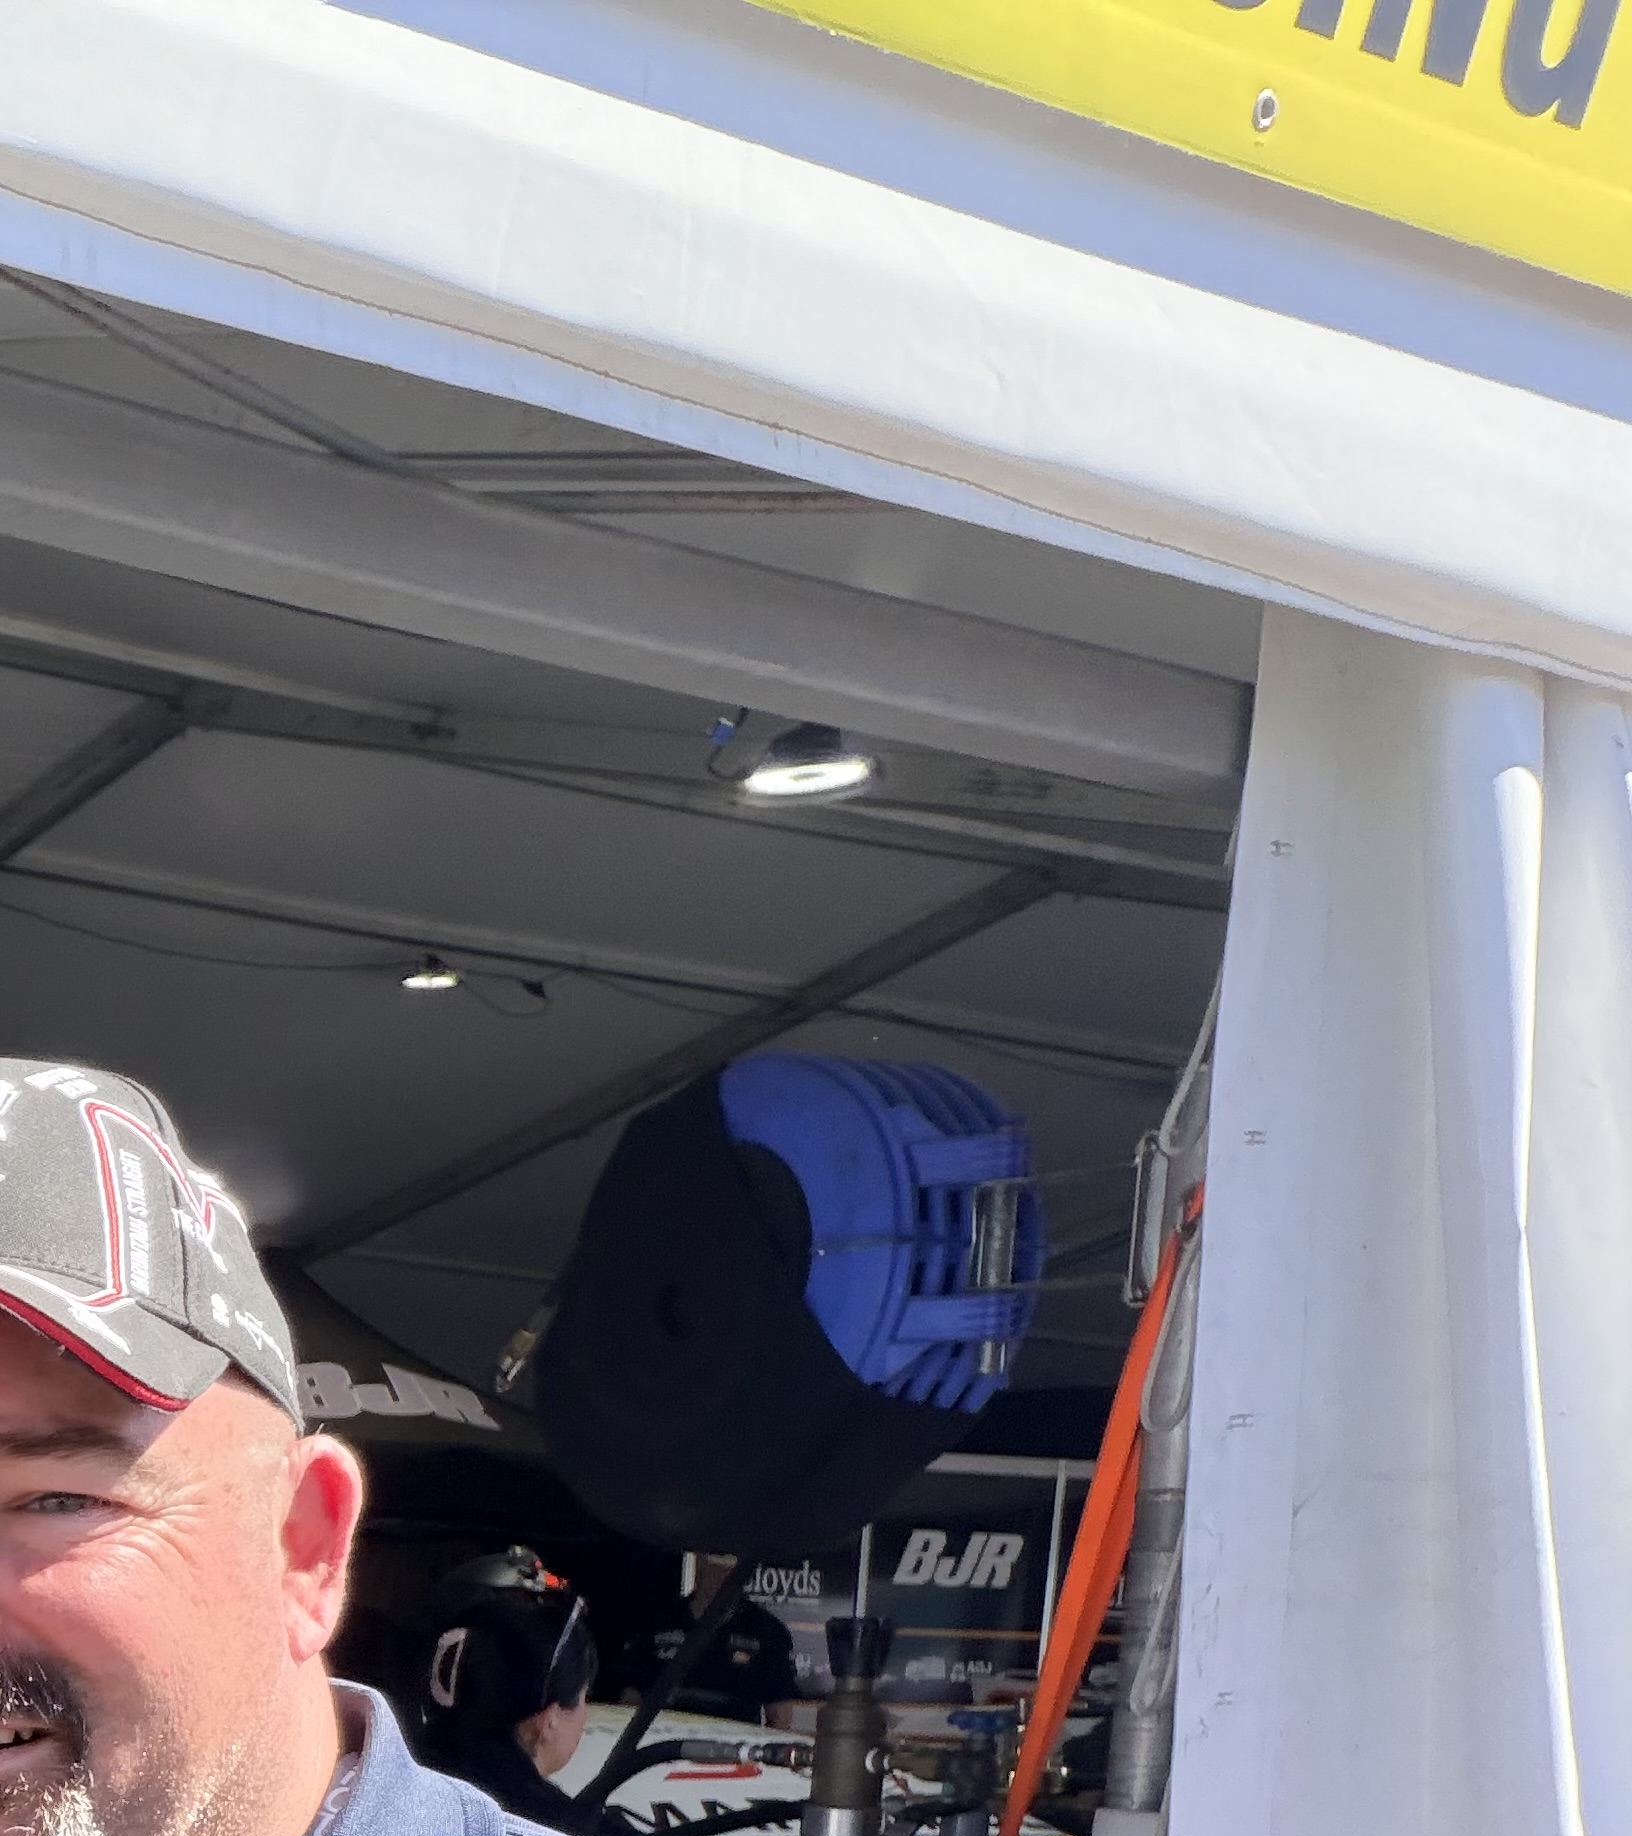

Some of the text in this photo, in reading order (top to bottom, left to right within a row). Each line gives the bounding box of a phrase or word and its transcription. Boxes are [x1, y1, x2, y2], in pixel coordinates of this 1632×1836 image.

[297, 1362, 502, 1431] BJR
[743, 1559, 822, 1599] loyds
[892, 1528, 1025, 1588] BJR
